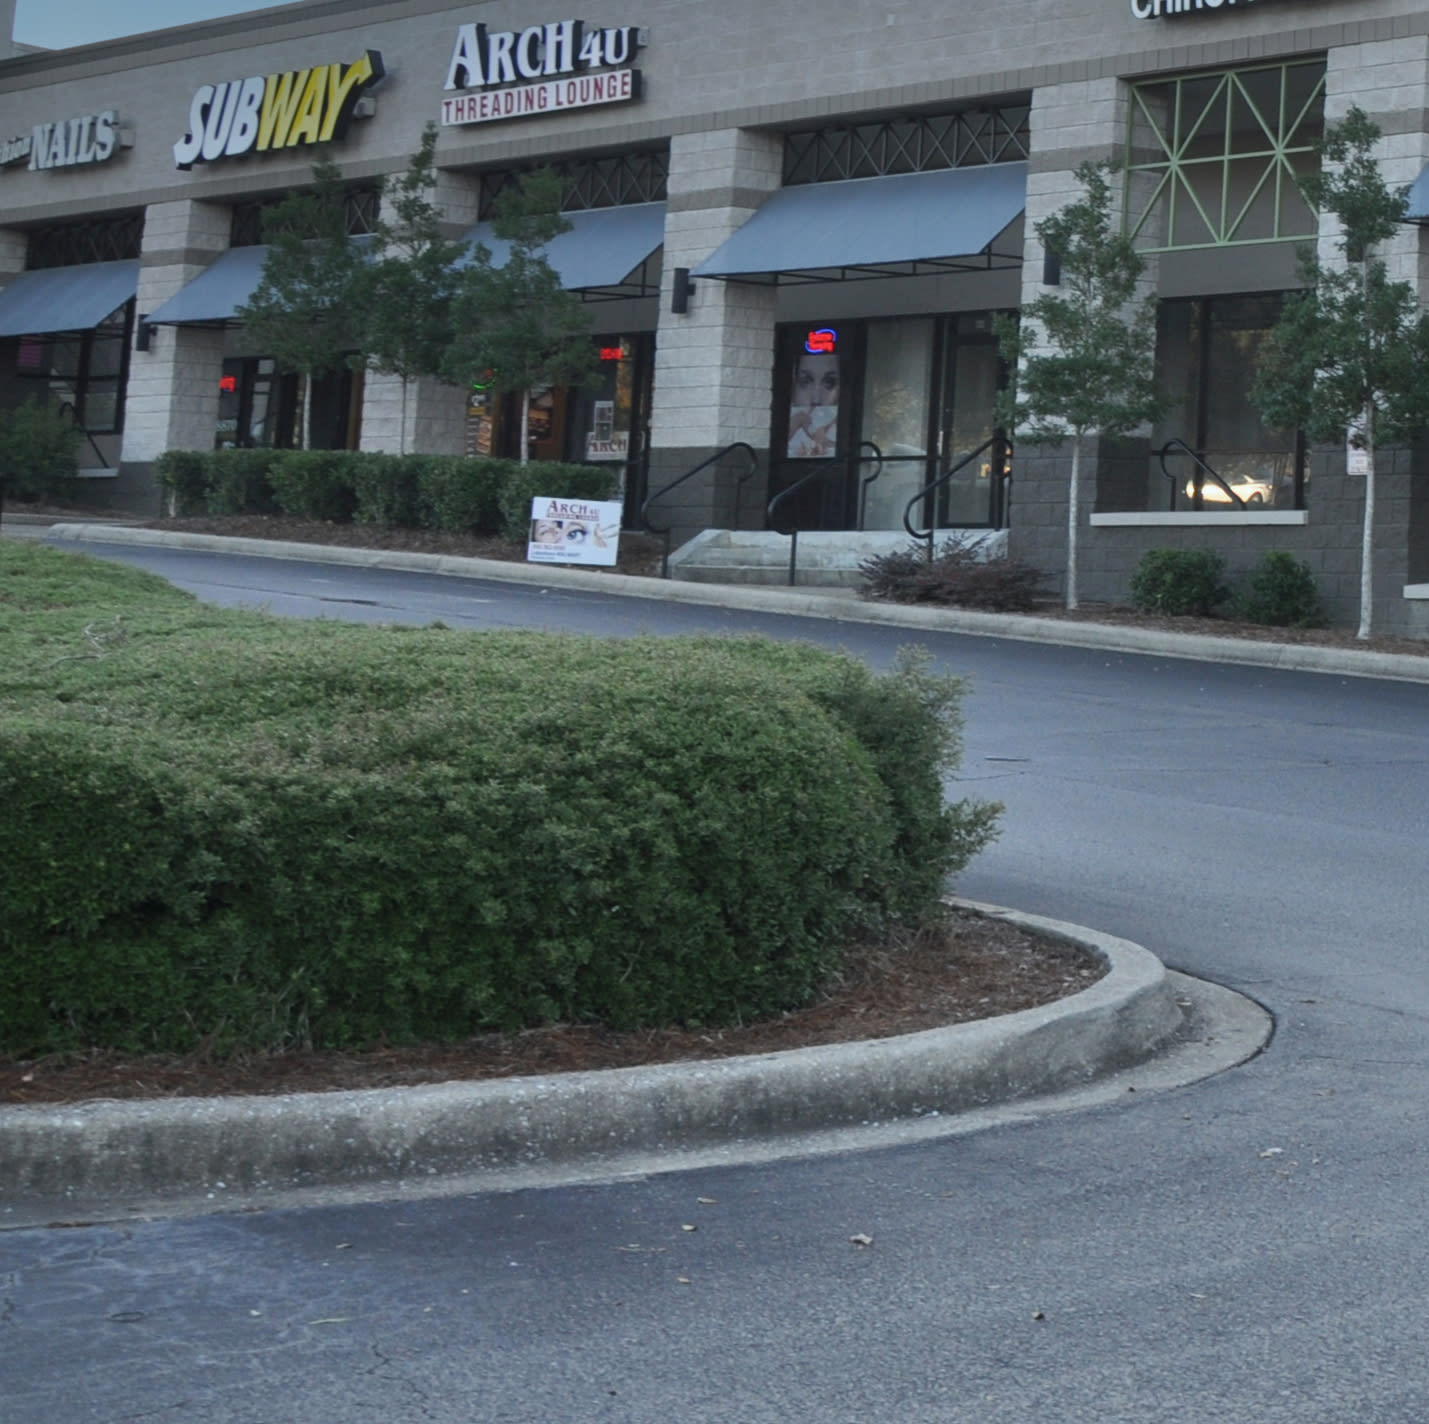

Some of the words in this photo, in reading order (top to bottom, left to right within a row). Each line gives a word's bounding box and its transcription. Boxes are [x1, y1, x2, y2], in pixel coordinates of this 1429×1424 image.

[444, 20, 577, 90] ARCH
[578, 27, 632, 68] 4U
[173, 49, 377, 167] SUBWAY
[444, 85, 548, 123] THREADING
[555, 73, 630, 106] LOUNGE
[28, 110, 117, 170] NAILS
[546, 500, 588, 514] ARCH
